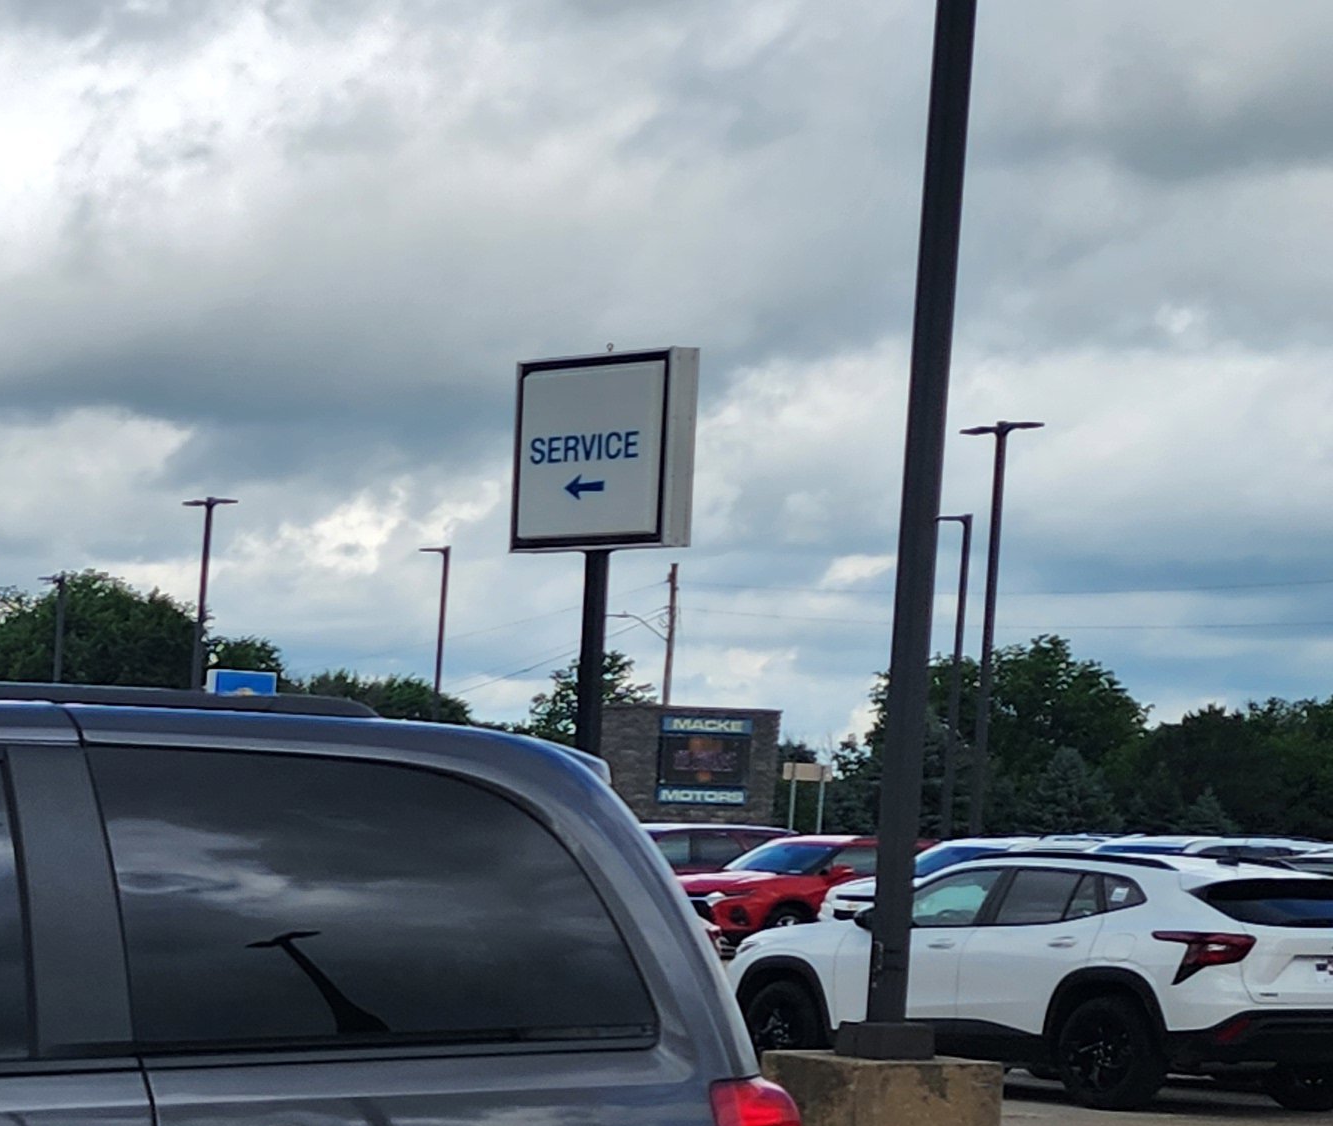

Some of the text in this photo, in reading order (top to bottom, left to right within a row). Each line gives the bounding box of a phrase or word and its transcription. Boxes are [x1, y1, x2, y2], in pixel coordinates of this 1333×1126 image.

[529, 430, 640, 466] SERVICE
[671, 718, 744, 732] MACKE
[658, 789, 745, 803] MOTORS
